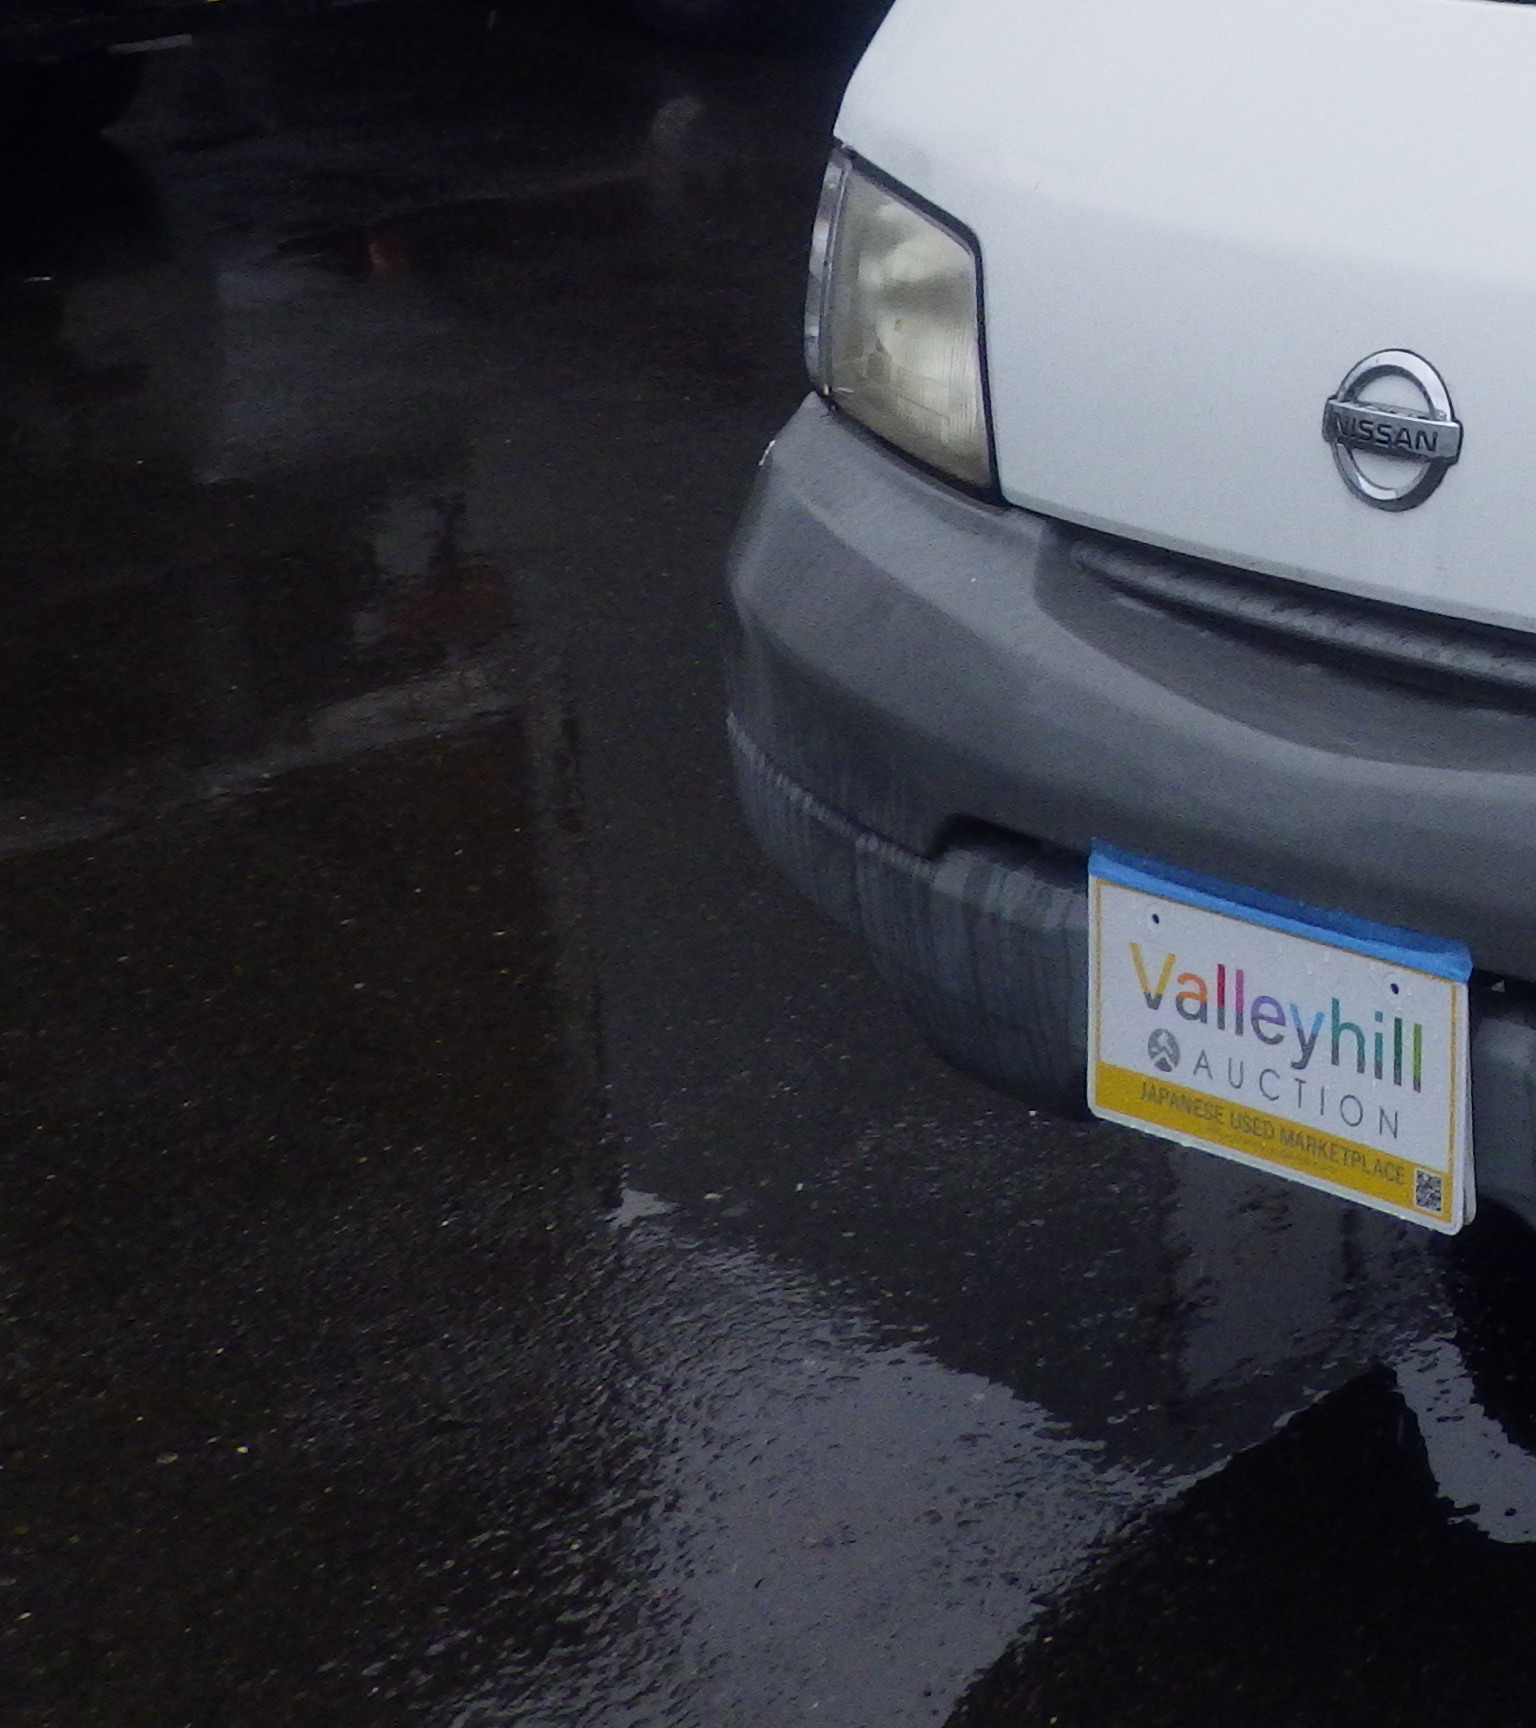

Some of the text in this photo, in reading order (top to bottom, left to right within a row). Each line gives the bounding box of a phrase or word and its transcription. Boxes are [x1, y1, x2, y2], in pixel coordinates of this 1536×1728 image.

[1333, 411, 1438, 452] NISSAN
[1129, 942, 1423, 1093] Valleyhill
[1139, 1080, 1225, 1125] JAPANESE
[1229, 1110, 1275, 1139] USED
[1279, 1127, 1406, 1186] MARKETPLACE
[1192, 1049, 1399, 1140] AUCTION
